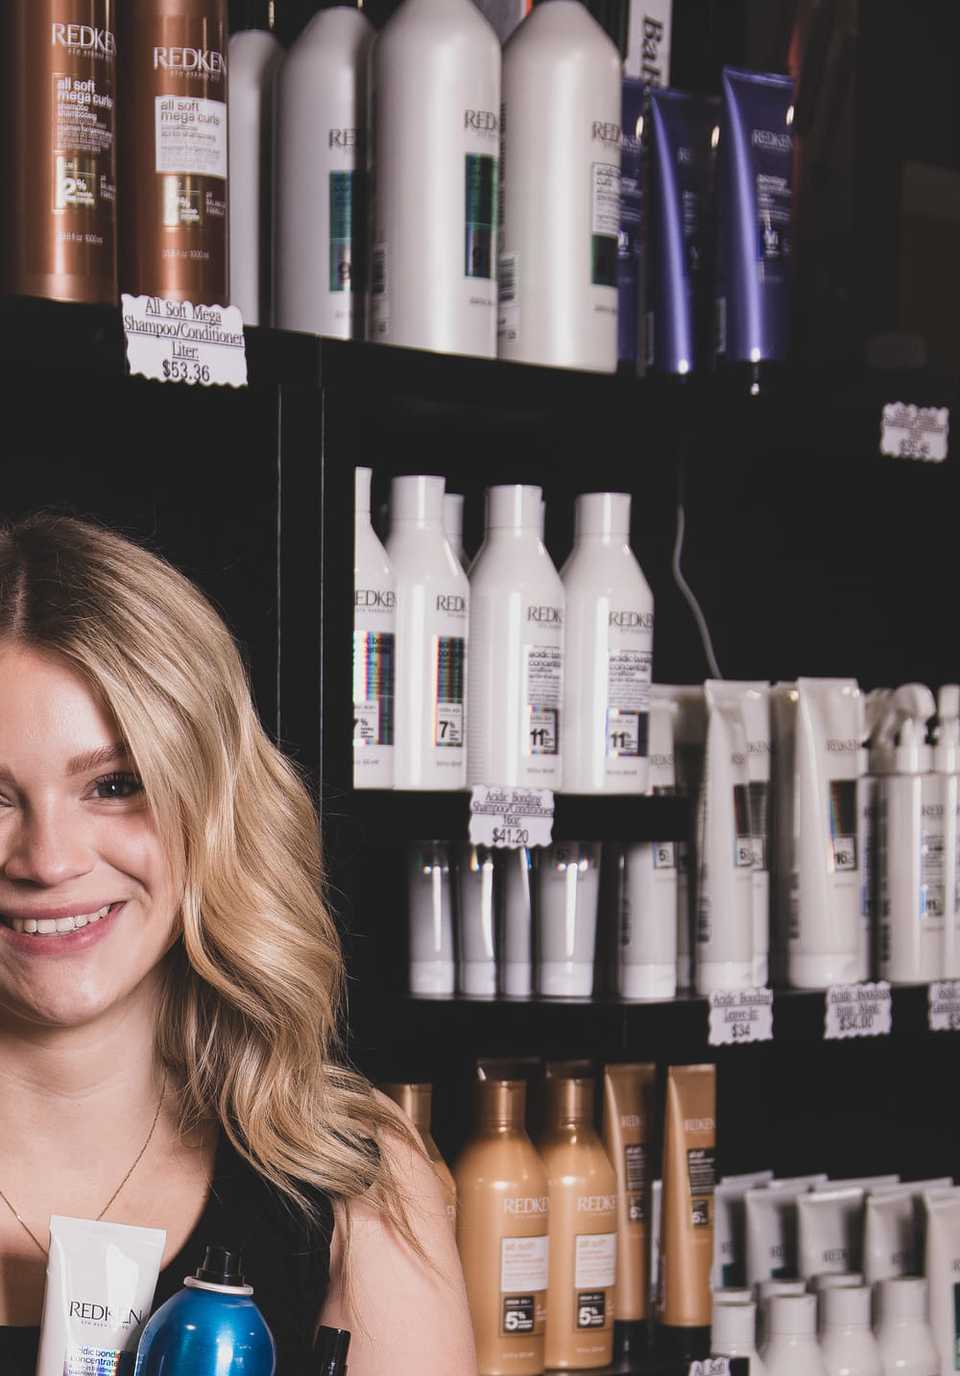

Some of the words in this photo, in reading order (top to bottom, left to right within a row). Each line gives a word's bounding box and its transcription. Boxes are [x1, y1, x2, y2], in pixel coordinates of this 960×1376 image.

[145, 298, 162, 315] All
[192, 305, 223, 326] Mega
[124, 314, 244, 346] Shampoo/Conditioner
[161, 358, 210, 383] $53.36
